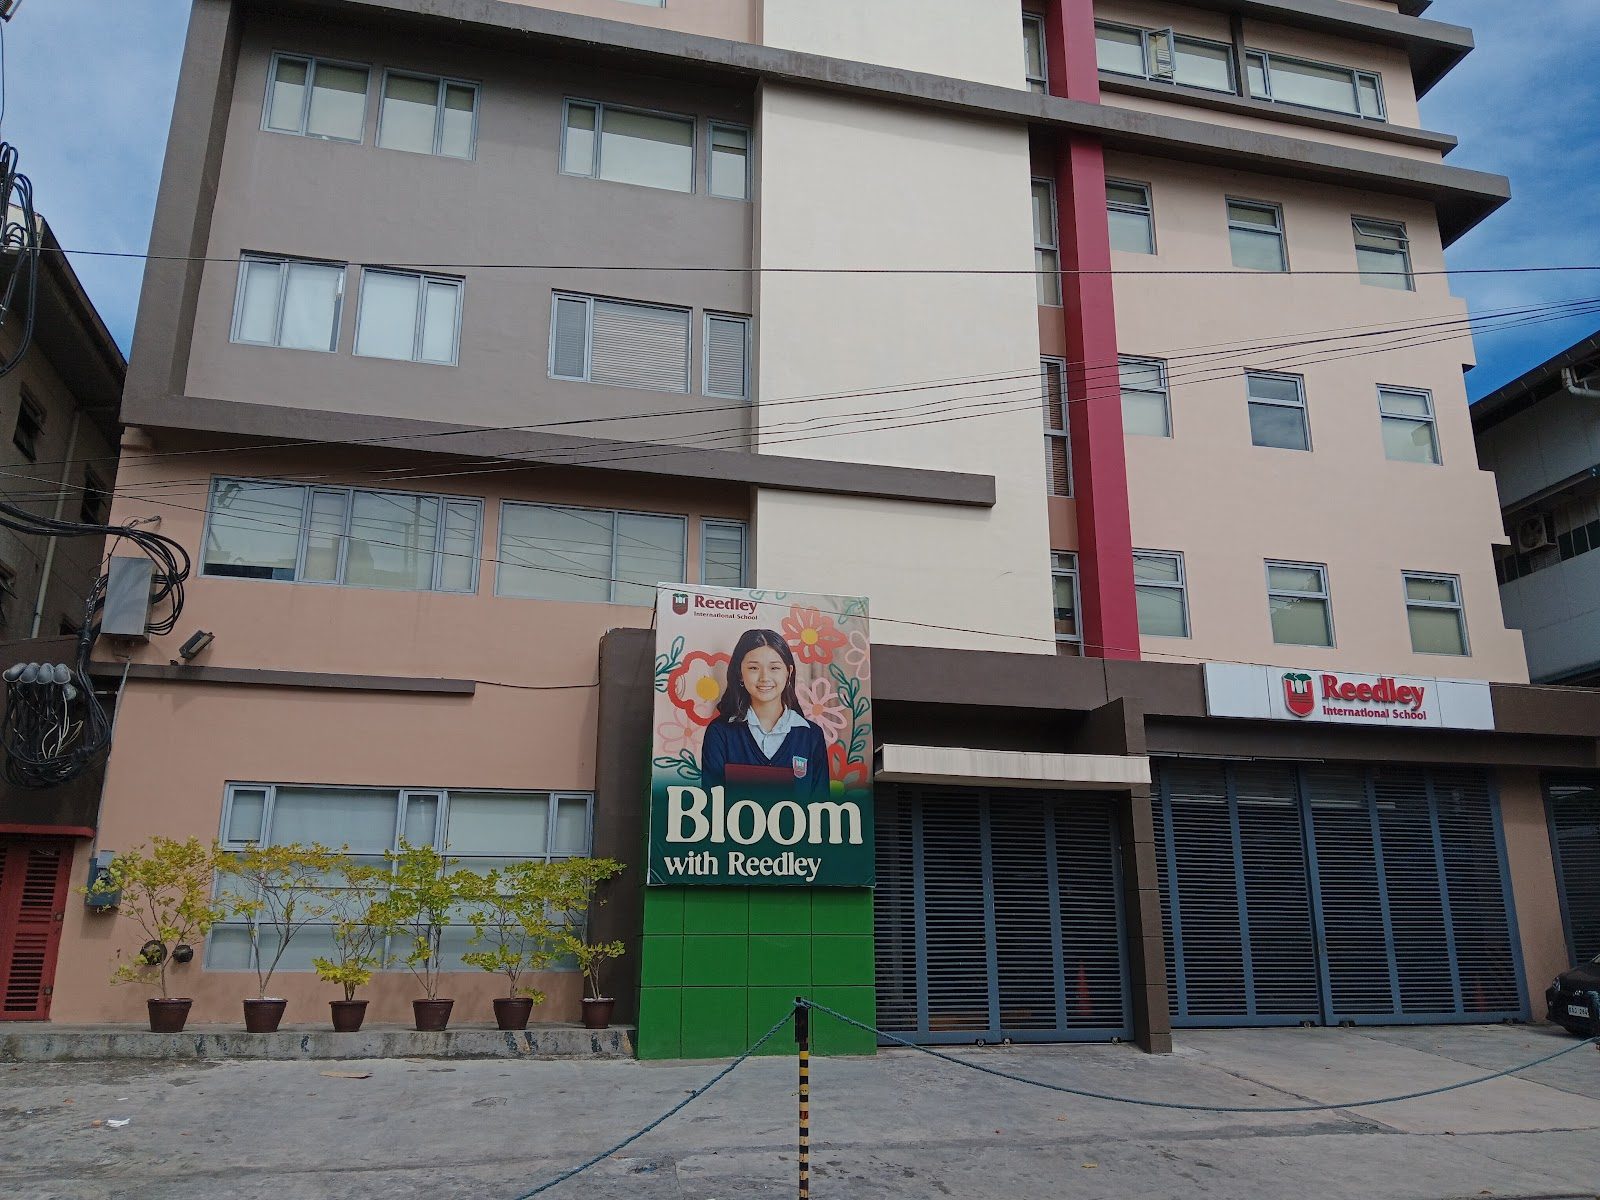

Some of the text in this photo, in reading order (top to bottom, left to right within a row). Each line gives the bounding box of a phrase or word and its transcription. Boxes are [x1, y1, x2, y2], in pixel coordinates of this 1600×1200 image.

[693, 612, 735, 620] International
[694, 594, 758, 614] Reedley
[1320, 674, 1425, 710] Reedley
[1322, 705, 1427, 721] International School
[666, 785, 863, 846] Bloom
[664, 850, 822, 882] with Reedley
